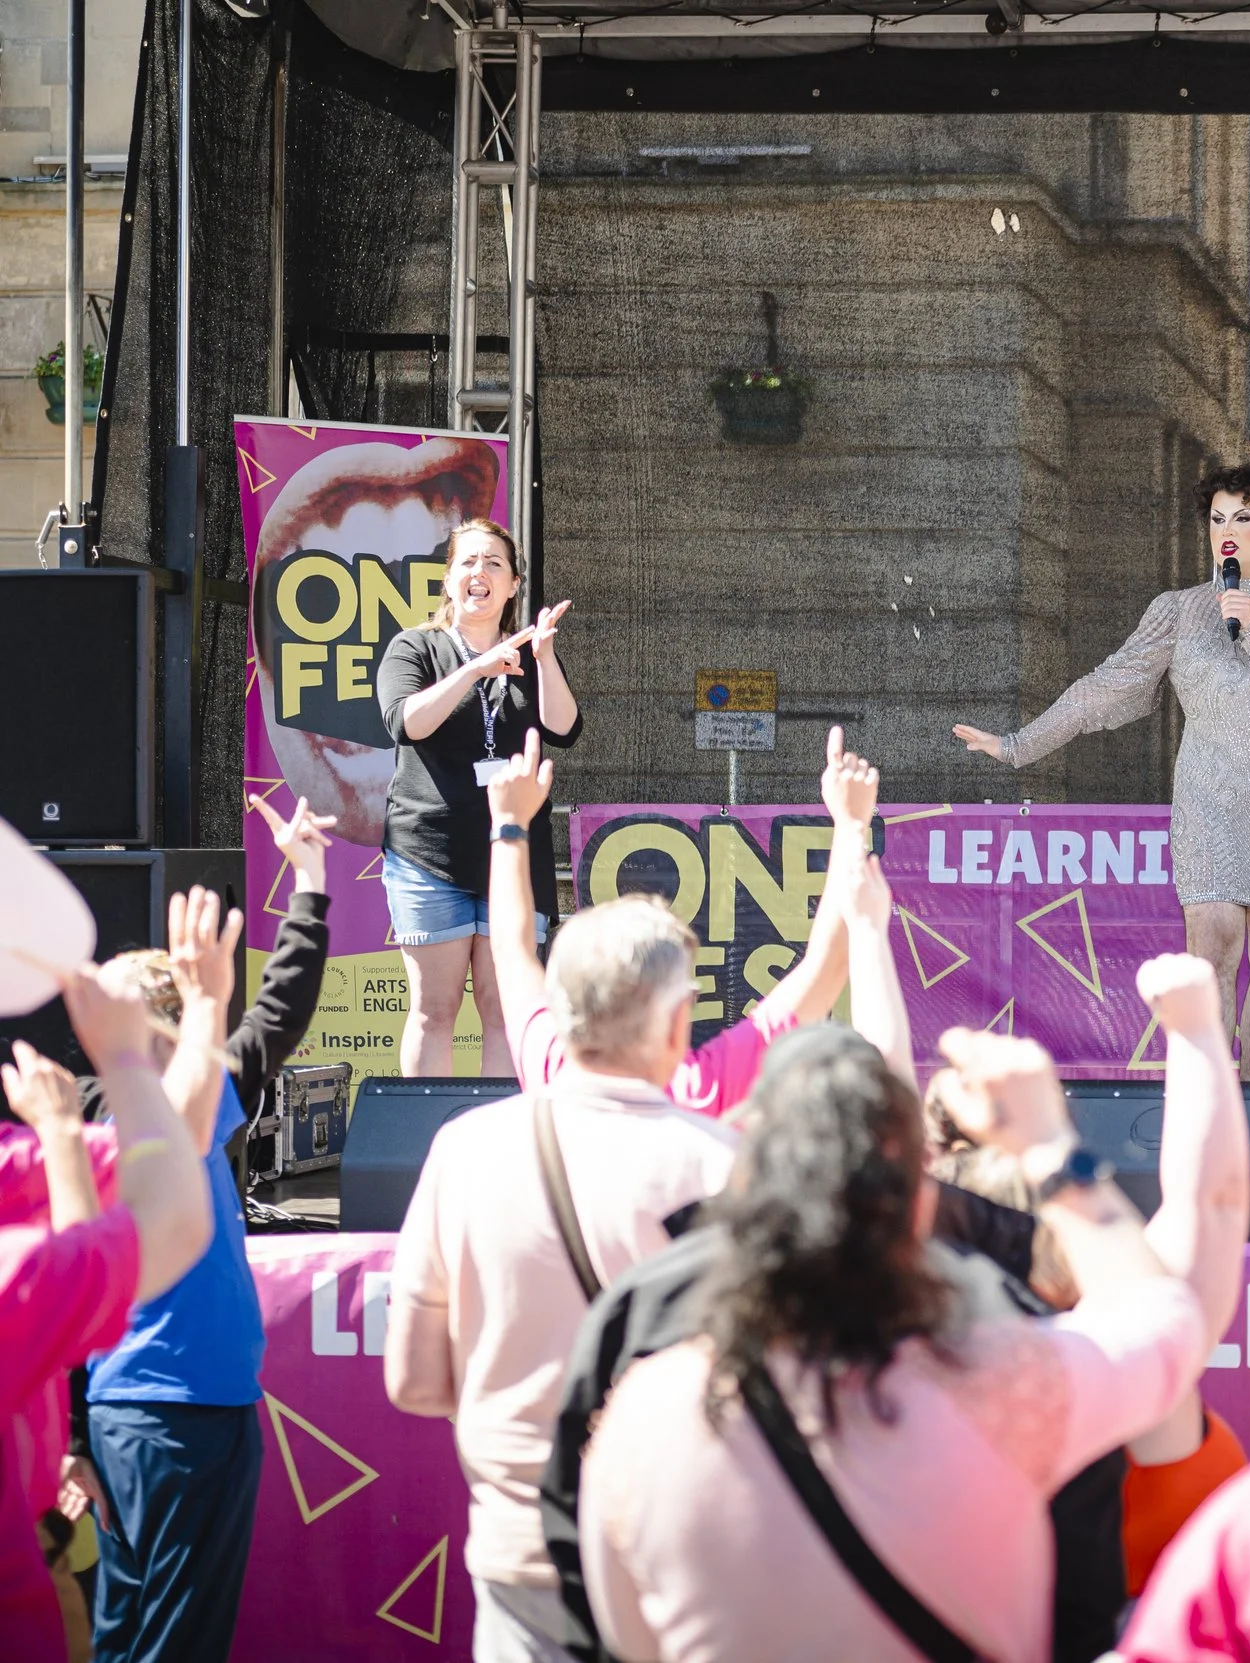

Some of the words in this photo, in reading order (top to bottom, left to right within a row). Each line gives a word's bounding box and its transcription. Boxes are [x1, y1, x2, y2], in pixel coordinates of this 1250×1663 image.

[928, 830, 1177, 884] LEARNI
[590, 823, 873, 942] ONE
[362, 966, 400, 974] Supported
[363, 979, 407, 993] ARTS
[363, 998, 410, 1012] ENGL
[322, 1031, 394, 1051] Inspire
